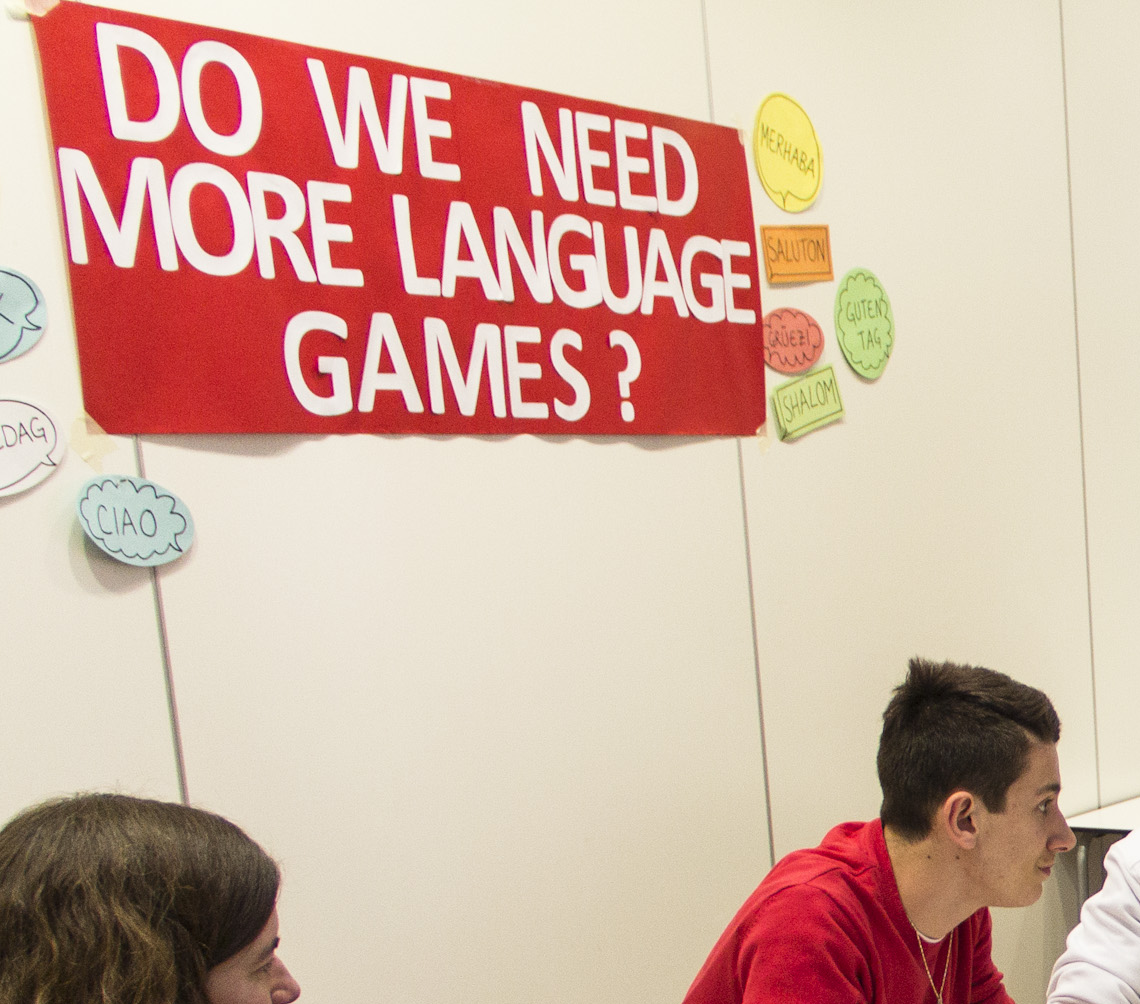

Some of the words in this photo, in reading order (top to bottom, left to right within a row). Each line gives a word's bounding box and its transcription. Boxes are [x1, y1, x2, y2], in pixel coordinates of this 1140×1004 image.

[95, 22, 263, 157] DO
[307, 58, 461, 182] WE
[521, 101, 699, 217] NEED
[761, 122, 816, 179] MERHABA
[58, 148, 364, 288] MORE
[393, 194, 756, 325] LANGUAGE
[767, 237, 826, 265] SALUTON
[846, 300, 884, 323] GUTEN
[858, 328, 882, 350] TAG
[284, 311, 591, 422] GAMES
[782, 377, 837, 424] SHALOM
[97, 503, 158, 538] CIAO
